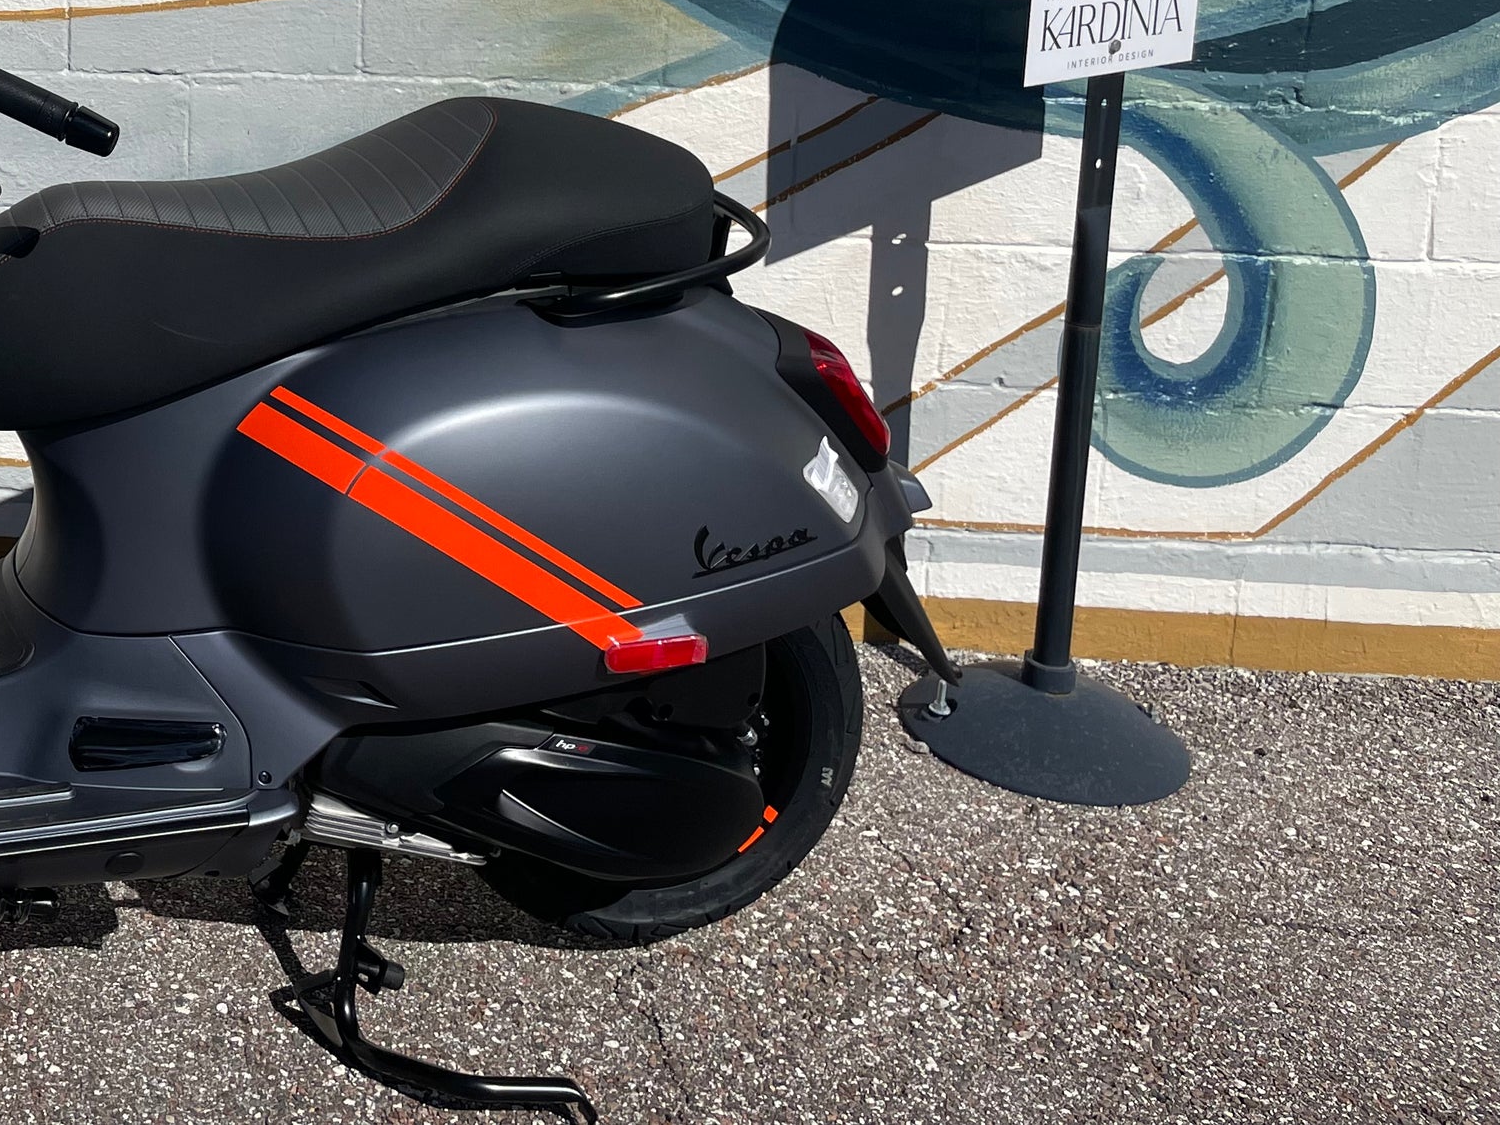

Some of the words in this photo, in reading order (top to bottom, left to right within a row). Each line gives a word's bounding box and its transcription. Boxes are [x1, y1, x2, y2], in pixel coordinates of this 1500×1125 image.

[1067, 53, 1113, 69] INTERIOR
[1118, 49, 1154, 62] DESIGN
[692, 524, 818, 579] Vespa
